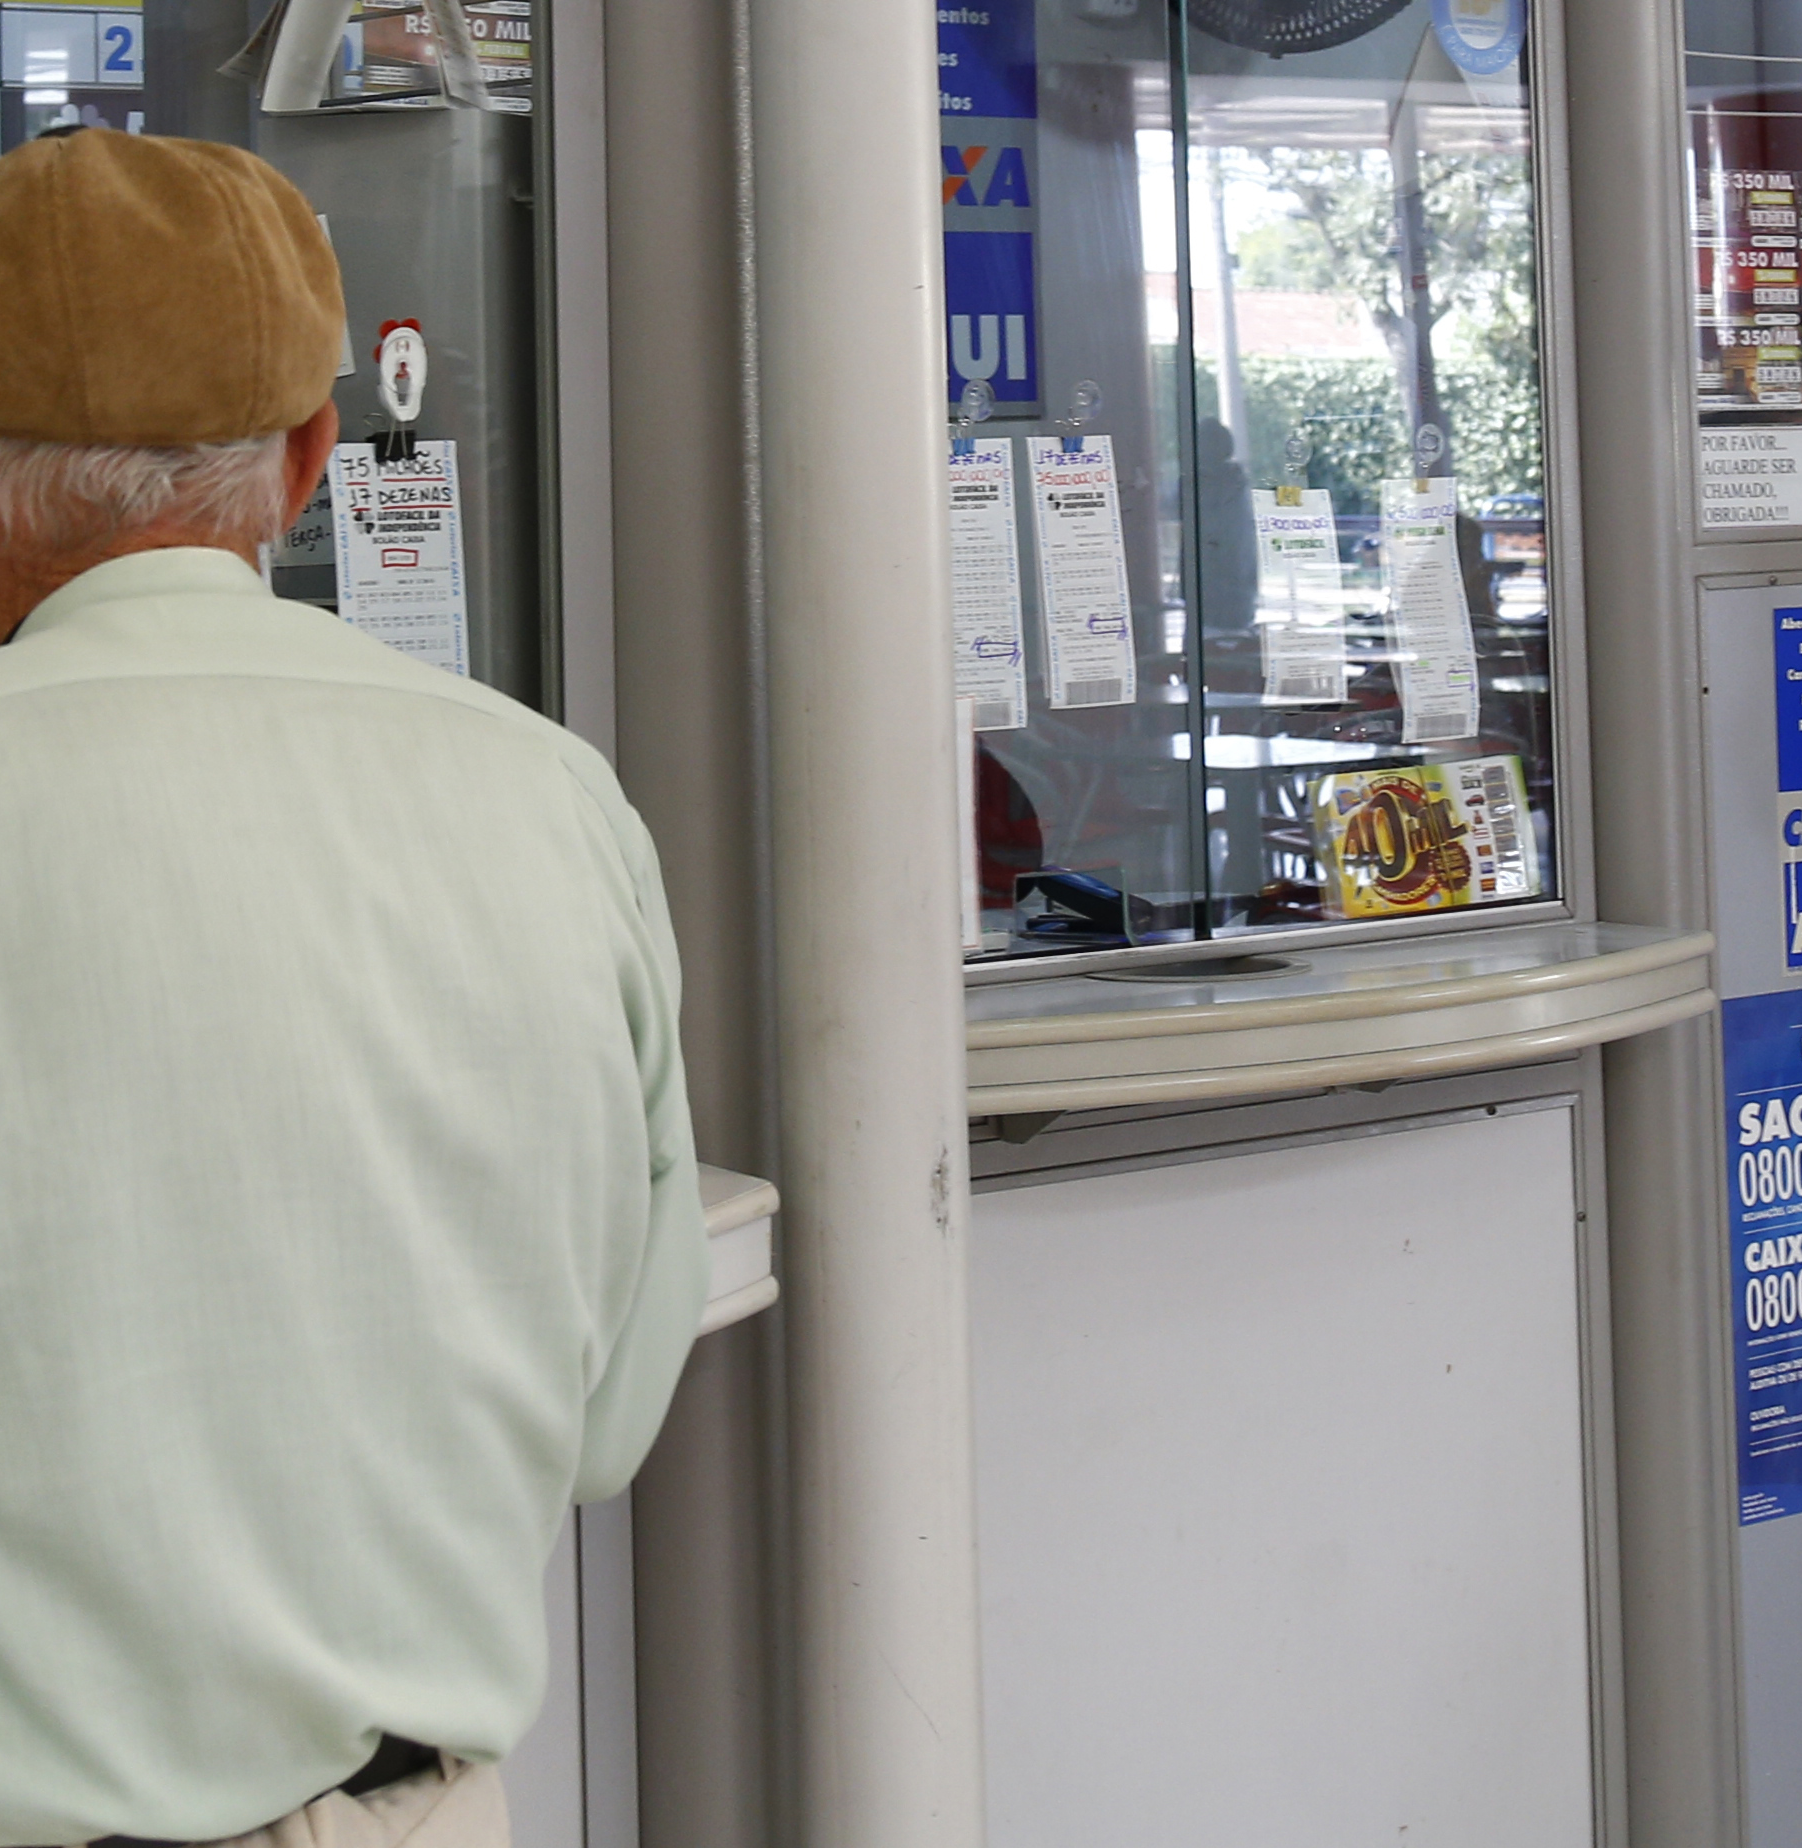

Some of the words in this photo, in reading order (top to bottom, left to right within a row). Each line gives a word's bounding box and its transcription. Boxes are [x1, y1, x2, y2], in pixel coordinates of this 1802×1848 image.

[340, 457, 371, 477] 75
[1703, 460, 1768, 475] AGUARDE
[1772, 458, 1797, 474] SER
[1703, 483, 1777, 500] CHAMADO,
